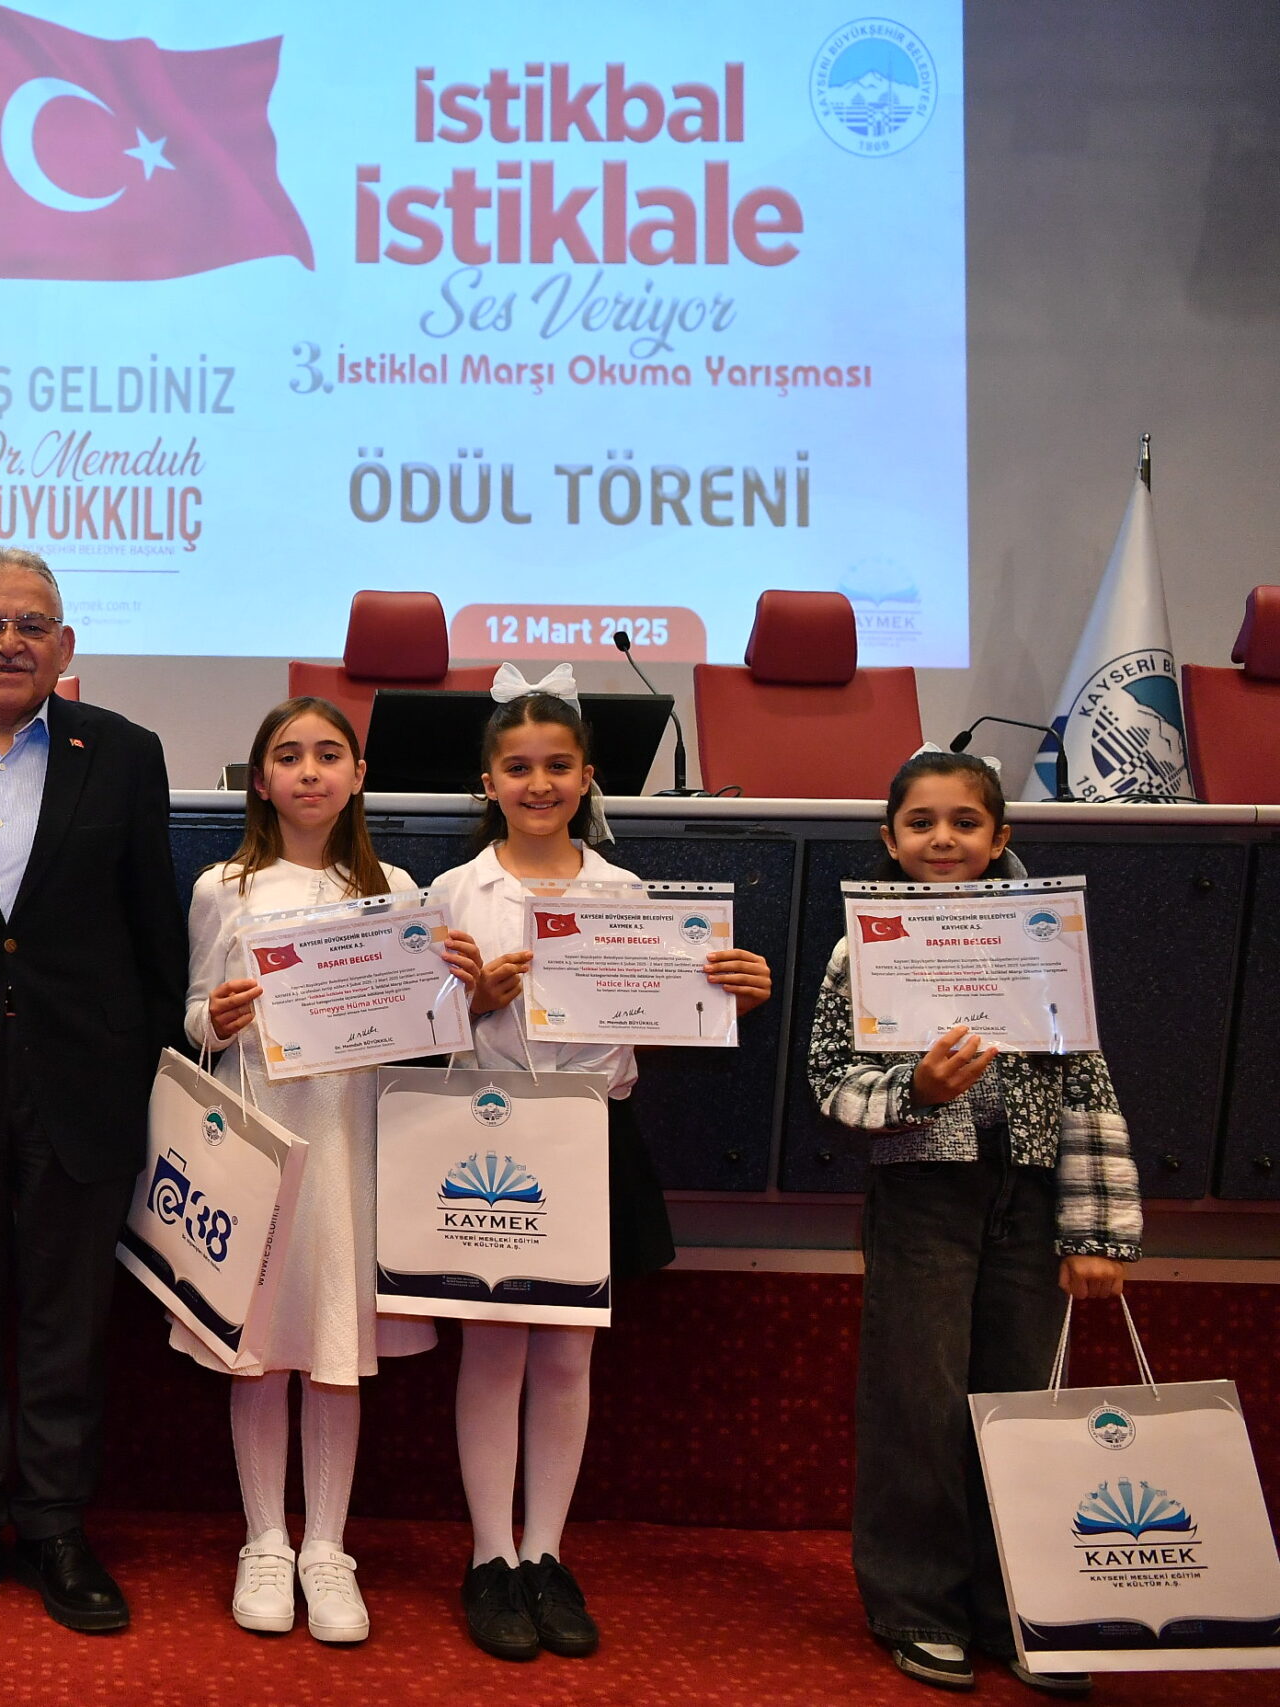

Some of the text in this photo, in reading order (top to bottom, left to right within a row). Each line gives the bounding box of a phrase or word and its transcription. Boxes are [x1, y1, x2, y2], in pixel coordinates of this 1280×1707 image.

[419, 266, 737, 358] Ses Veriyor
[289, 340, 873, 397] 3. İstiklal Marşı Okuma Yarışması
[28, 353, 236, 415] GELDİNİZ
[31, 430, 206, 482] Memduh
[349, 446, 811, 528] ÖDÜL TÖRENİ
[486, 616, 518, 643] 12
[526, 617, 593, 645] Mart
[1078, 655, 1156, 718] KAYSERİ
[936, 914, 977, 922] BÜYÜKŞEHİR
[979, 912, 1017, 920] BELEDİYESİ
[300, 928, 393, 948] KAYSERİ BÜYÜKŞEHİR BELEDİYESİ
[594, 936, 660, 945] BAŞARI BELGESİ
[926, 936, 1002, 947] BAŞARI BELGESİ
[330, 944, 353, 952] KAYMEK
[317, 952, 382, 970] BAŞARI BELGESİ
[623, 980, 640, 988] İkra
[642, 981, 661, 989] ÇAM
[937, 984, 998, 992] Ela KABUKCU
[309, 1005, 345, 1016] Sümeyye
[347, 1001, 371, 1010] Hüma
[372, 995, 406, 1006] KUYUCU
[444, 1212, 539, 1231] KAYMEK
[474, 1241, 505, 1249] KÜLTÜR
[1085, 1548, 1197, 1566] KAYMEK
[1126, 1580, 1161, 1588] KÜLTÜR
